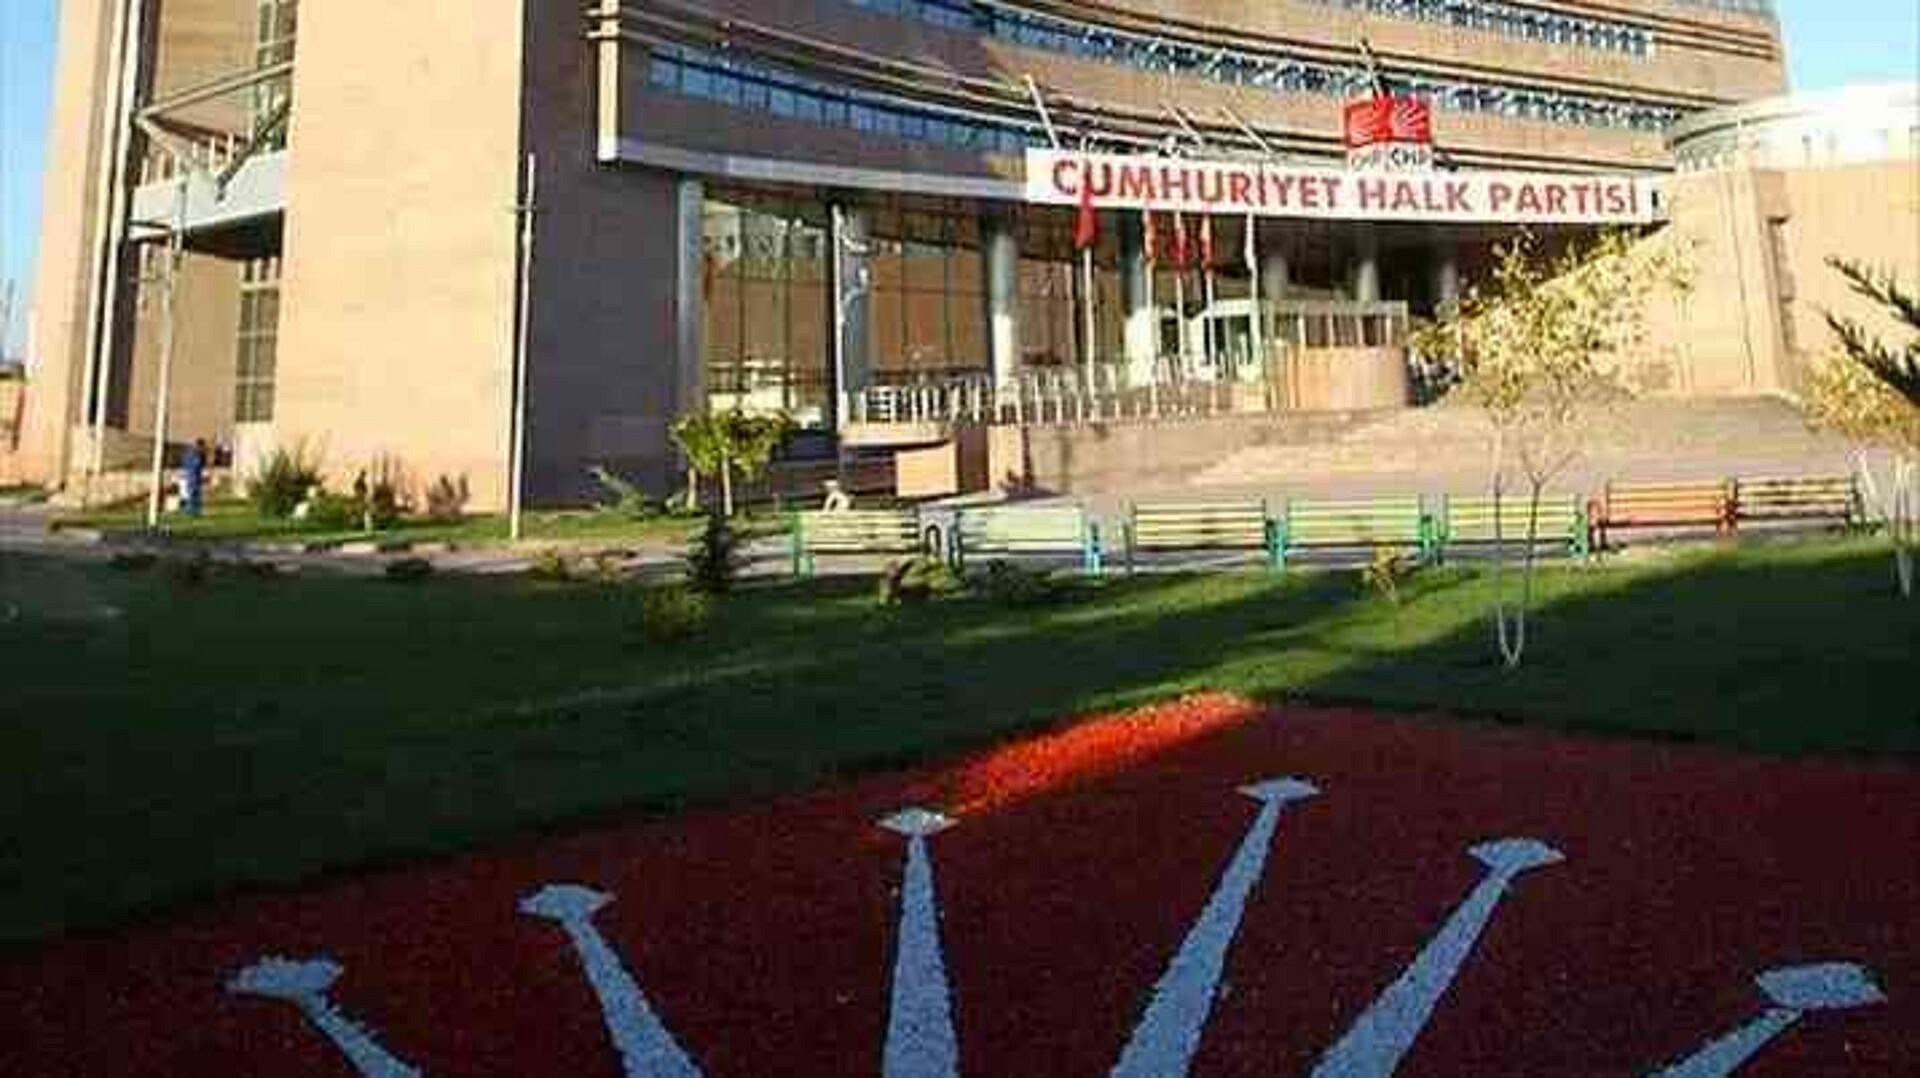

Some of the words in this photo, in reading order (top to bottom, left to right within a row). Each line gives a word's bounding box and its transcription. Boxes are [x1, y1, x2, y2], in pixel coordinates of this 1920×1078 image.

[1052, 158, 1341, 209] CUMHURİYET
[1357, 177, 1472, 212] HALK
[1488, 174, 1638, 215] PARTİSİ
